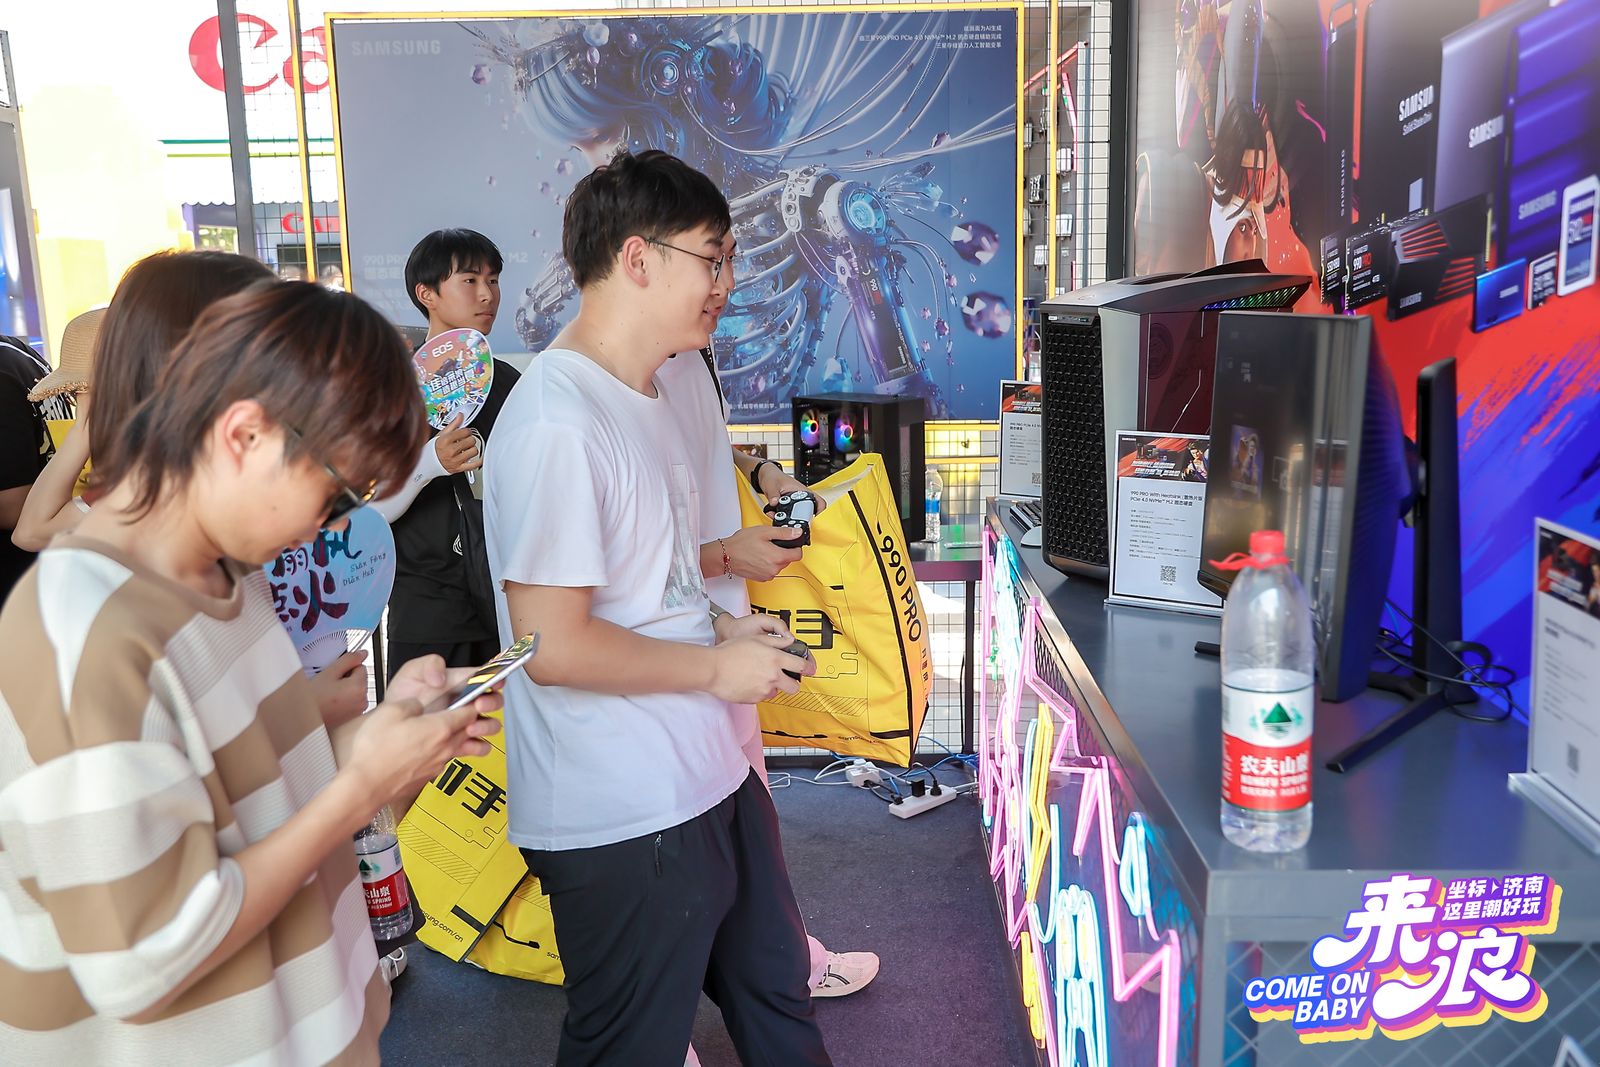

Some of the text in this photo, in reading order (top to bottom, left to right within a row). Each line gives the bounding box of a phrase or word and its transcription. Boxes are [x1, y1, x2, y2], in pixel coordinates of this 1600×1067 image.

[351, 40, 441, 56] SAMSUNG
[432, 341, 454, 358] EOS
[880, 534, 922, 643] 990 PRO
